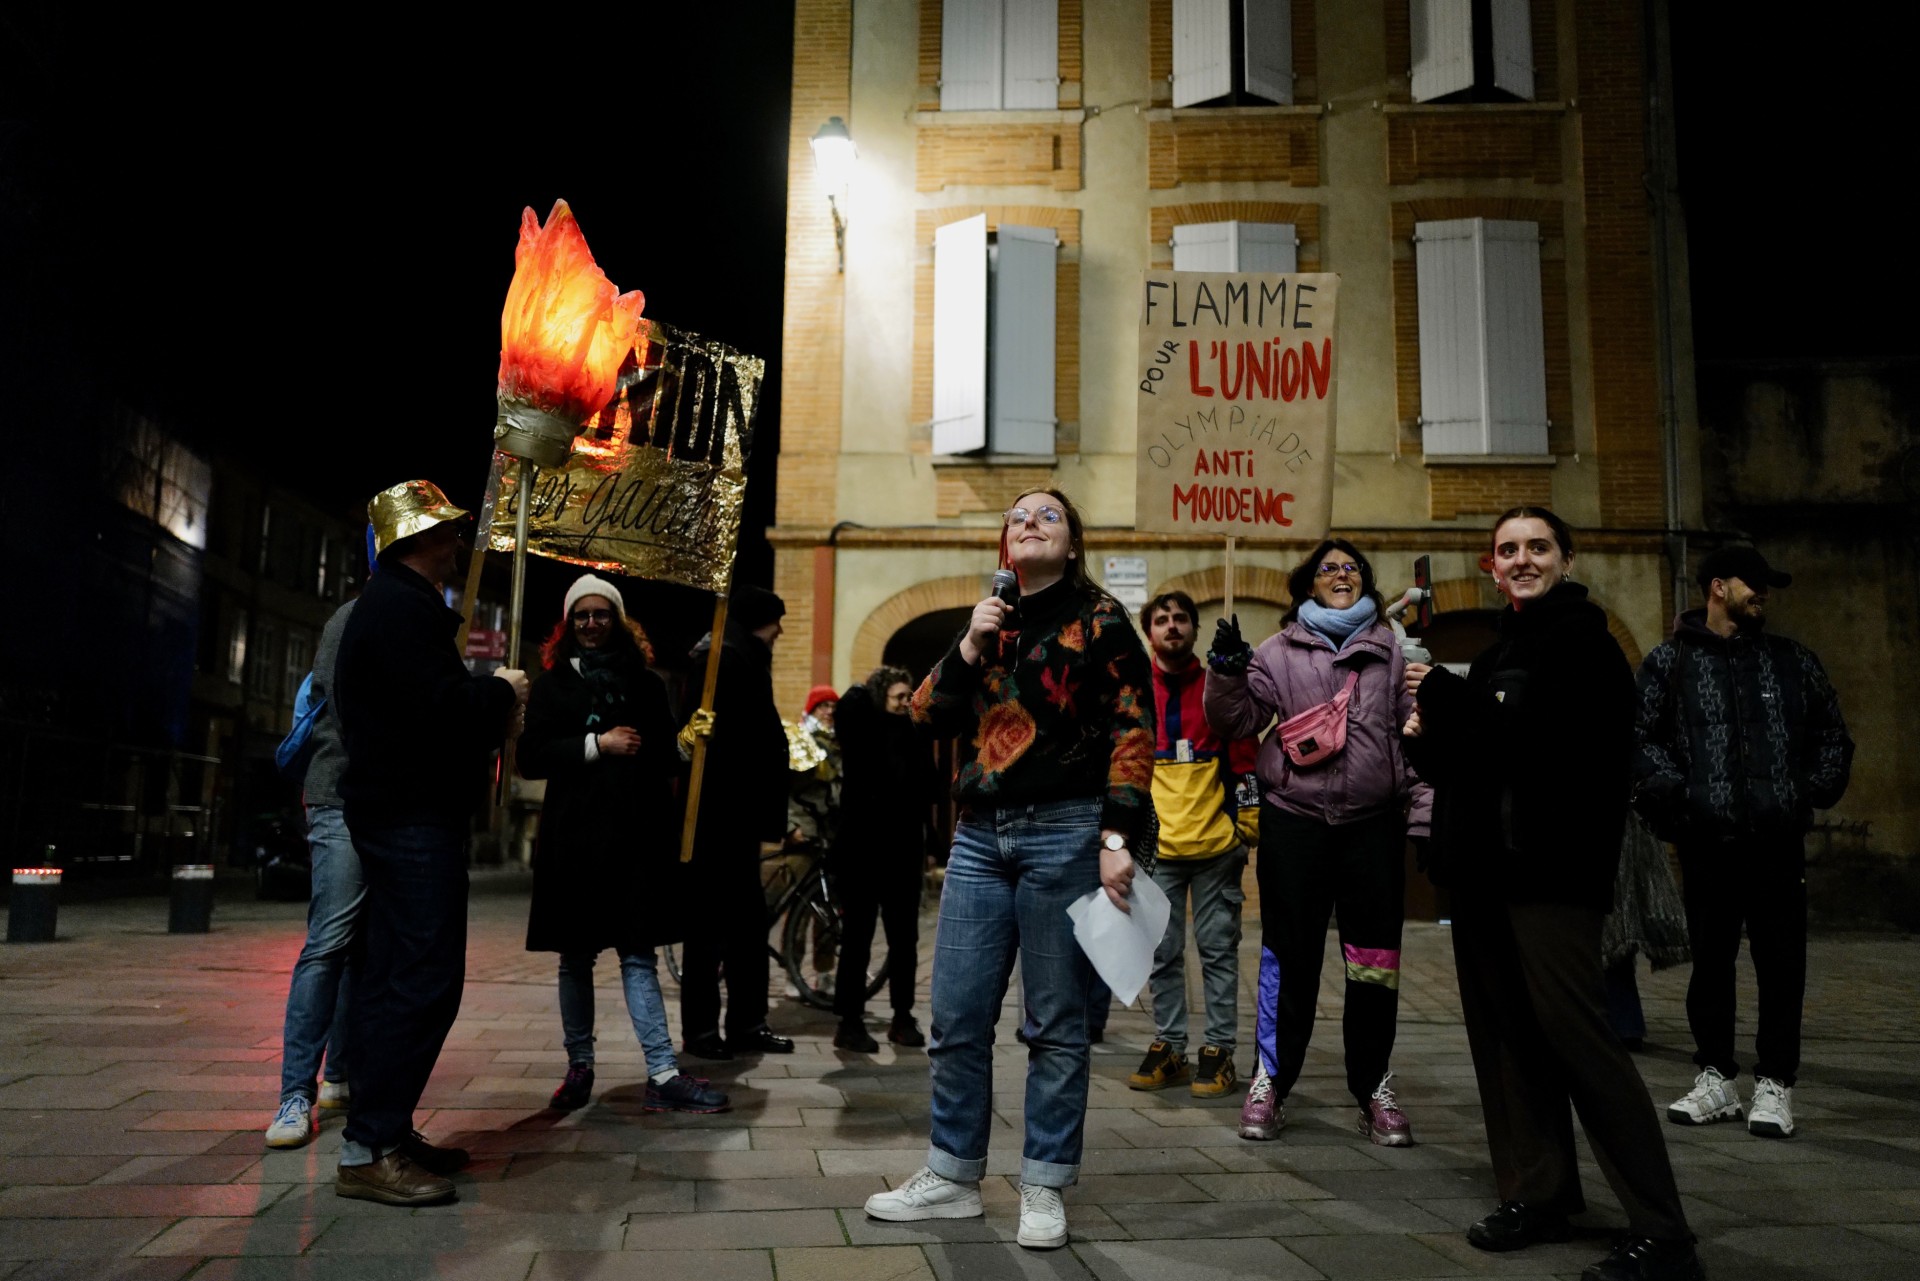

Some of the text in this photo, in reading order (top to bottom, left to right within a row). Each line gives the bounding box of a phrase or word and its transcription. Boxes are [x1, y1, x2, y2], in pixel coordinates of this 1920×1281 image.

[1146, 278, 1318, 330] FLAMME
[1140, 340, 1181, 395] POUR
[1172, 483, 1296, 527] MOUDENC
